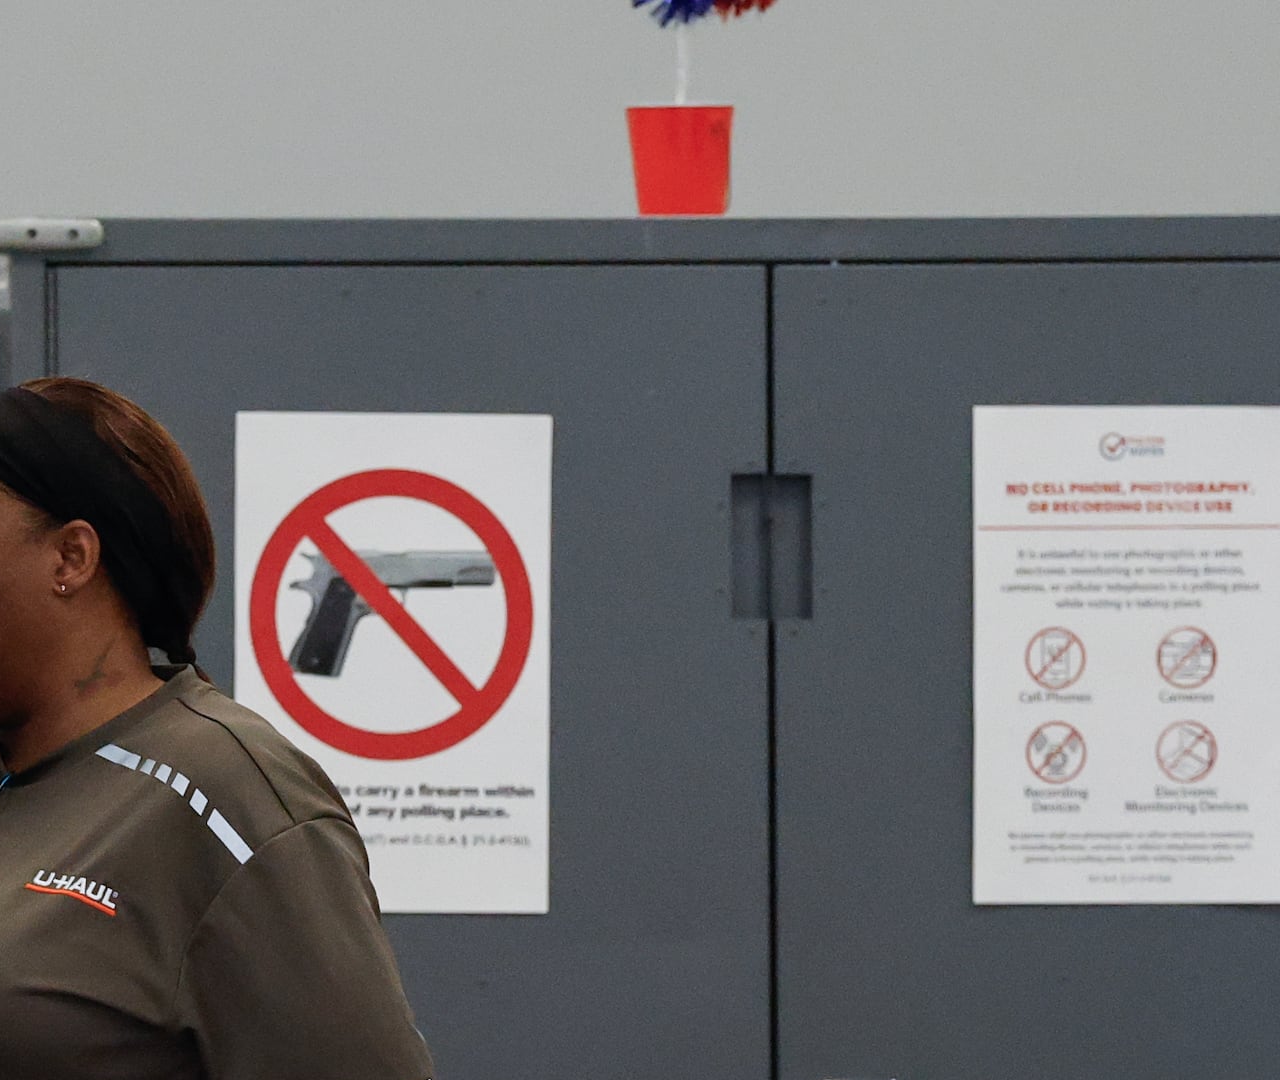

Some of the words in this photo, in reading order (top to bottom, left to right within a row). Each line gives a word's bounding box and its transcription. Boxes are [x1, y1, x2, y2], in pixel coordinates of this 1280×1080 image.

[1006, 483, 1029, 496] NO
[1032, 483, 1065, 495] CELL
[1053, 501, 1143, 513] RECORDING
[1205, 500, 1233, 513] USE
[356, 786, 399, 800] carry
[404, 787, 414, 796] a
[419, 783, 479, 797] firearm
[485, 786, 535, 797] within
[368, 807, 395, 820] any
[401, 805, 454, 820] polling
